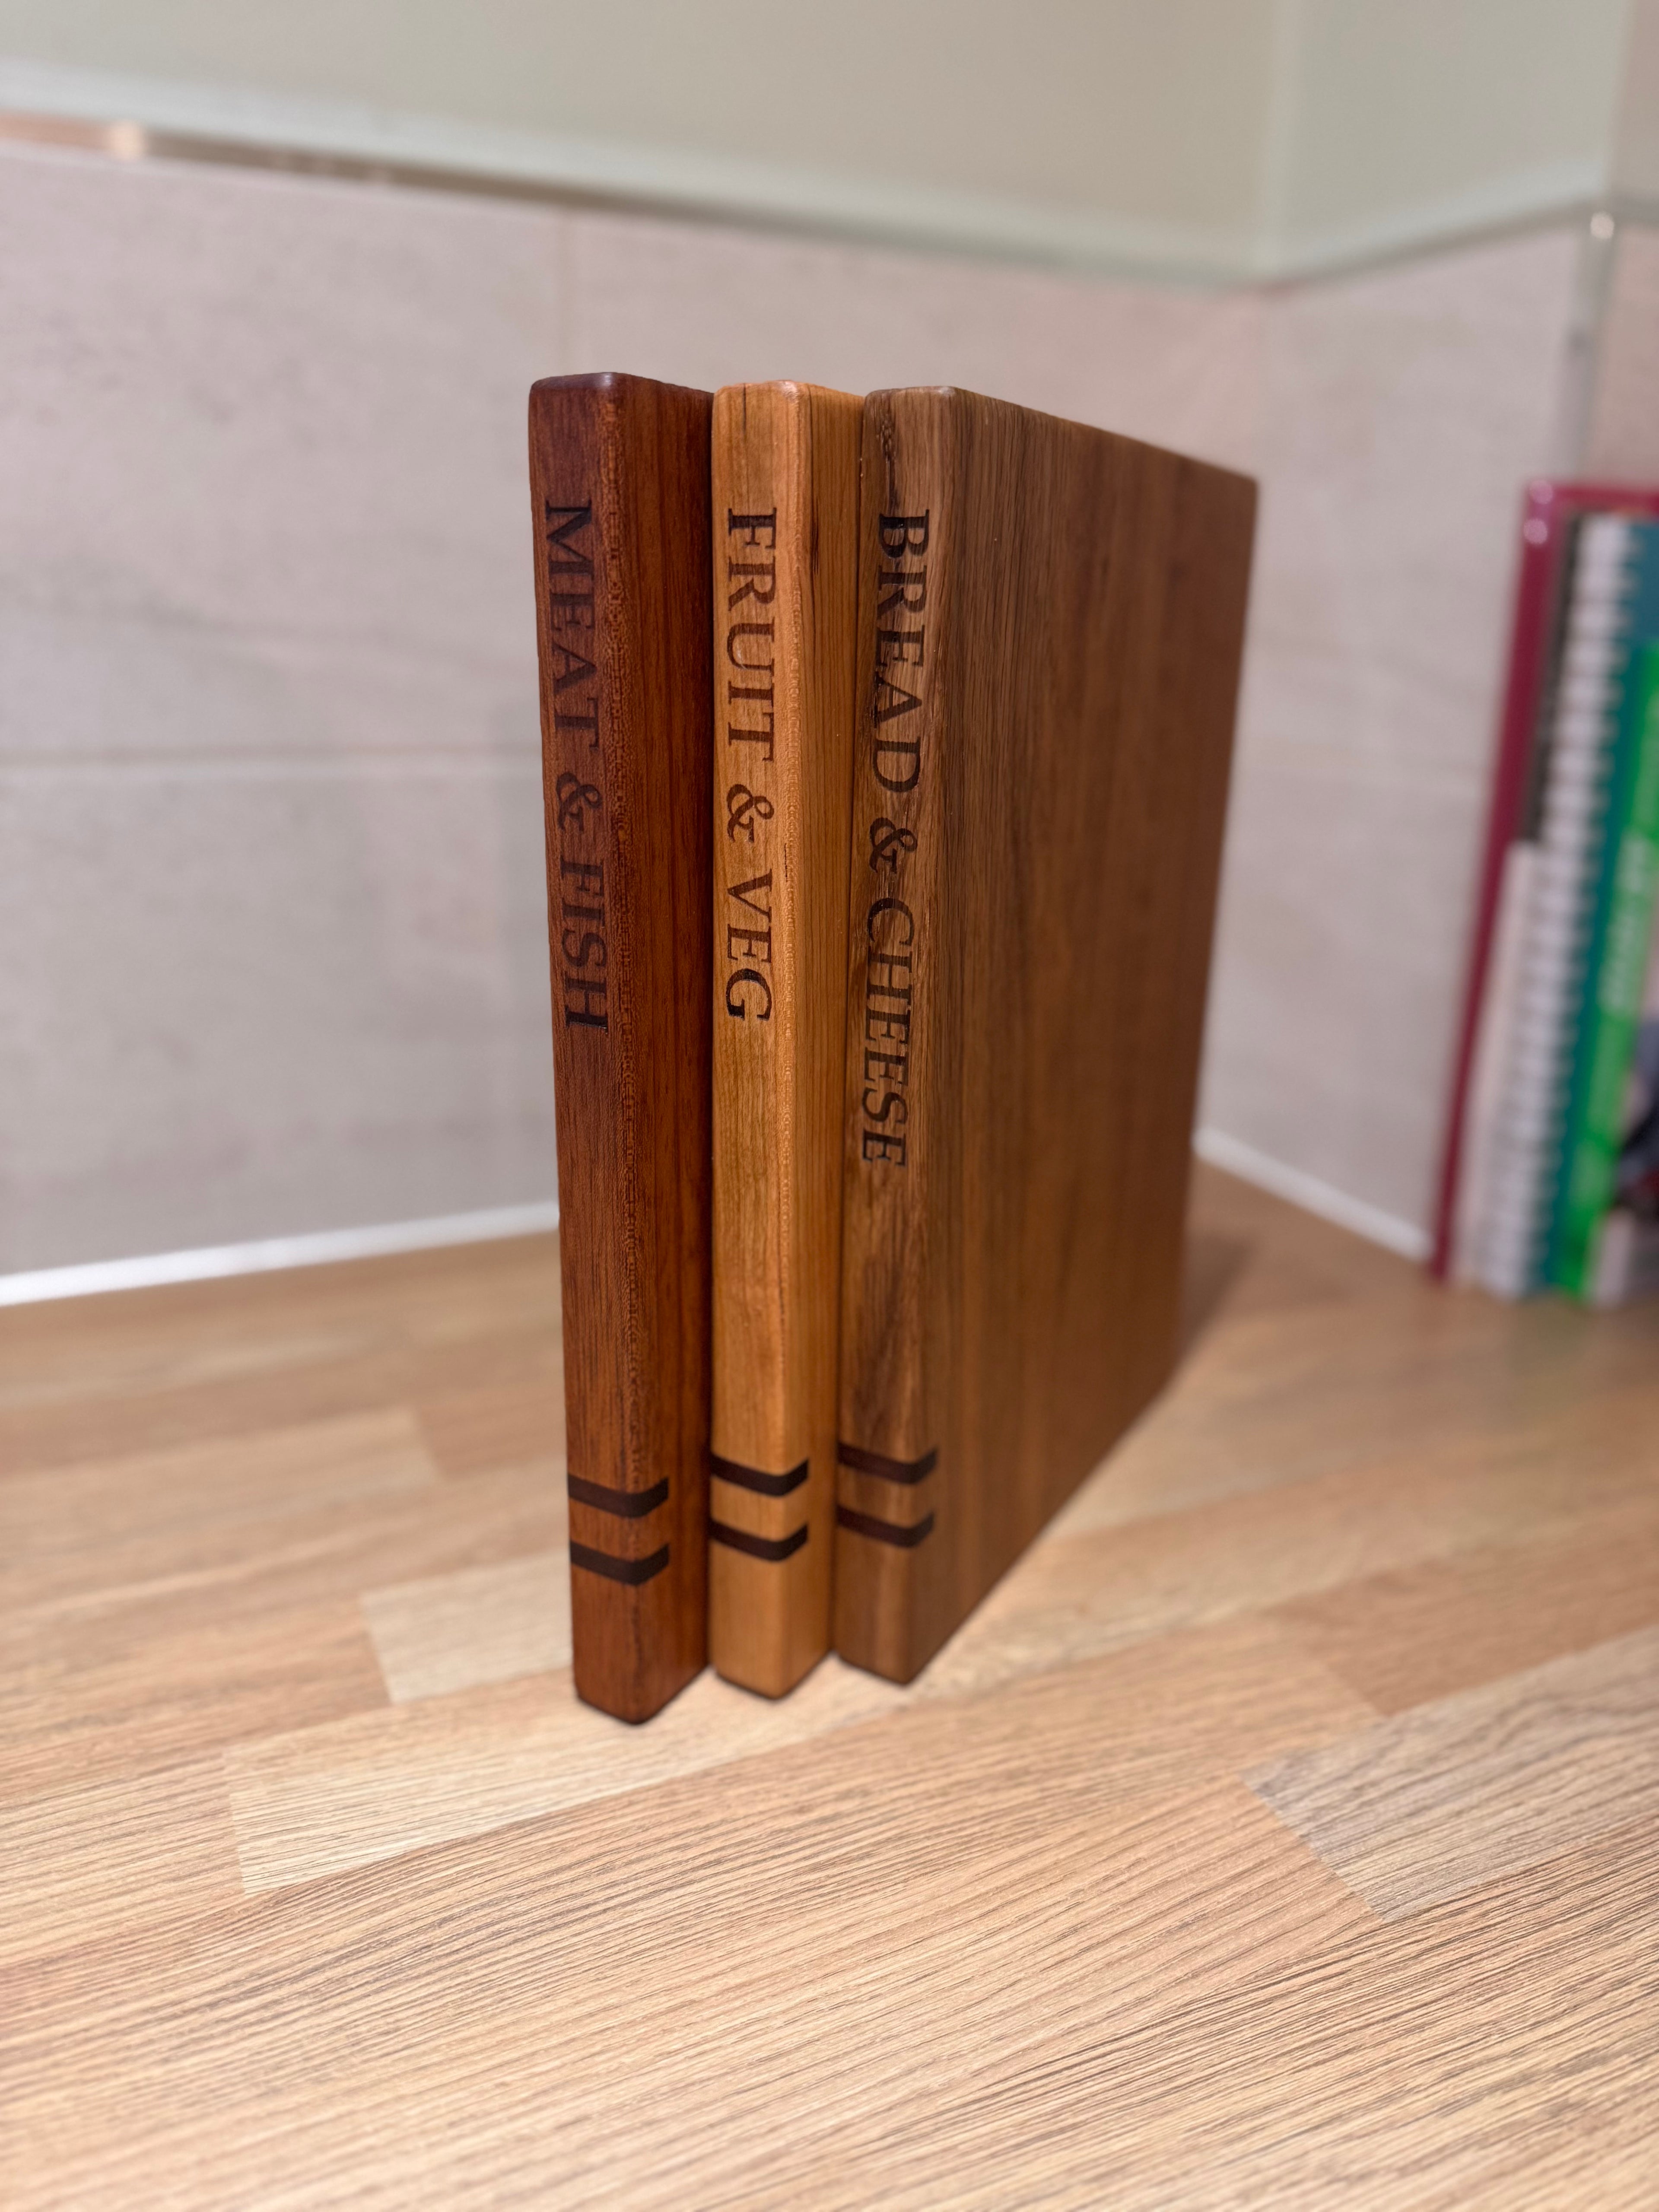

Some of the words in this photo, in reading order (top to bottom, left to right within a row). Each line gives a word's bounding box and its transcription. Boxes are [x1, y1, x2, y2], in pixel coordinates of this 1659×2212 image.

[545, 499, 599, 753] MEAT
[726, 507, 776, 762] FRUIT
[871, 509, 929, 793] BREAD
[556, 772, 602, 832] &
[726, 783, 775, 842] &
[868, 817, 918, 875] &
[560, 855, 608, 1030] FISH
[725, 868, 773, 1020] VEG
[861, 897, 915, 1167] CHEESE
